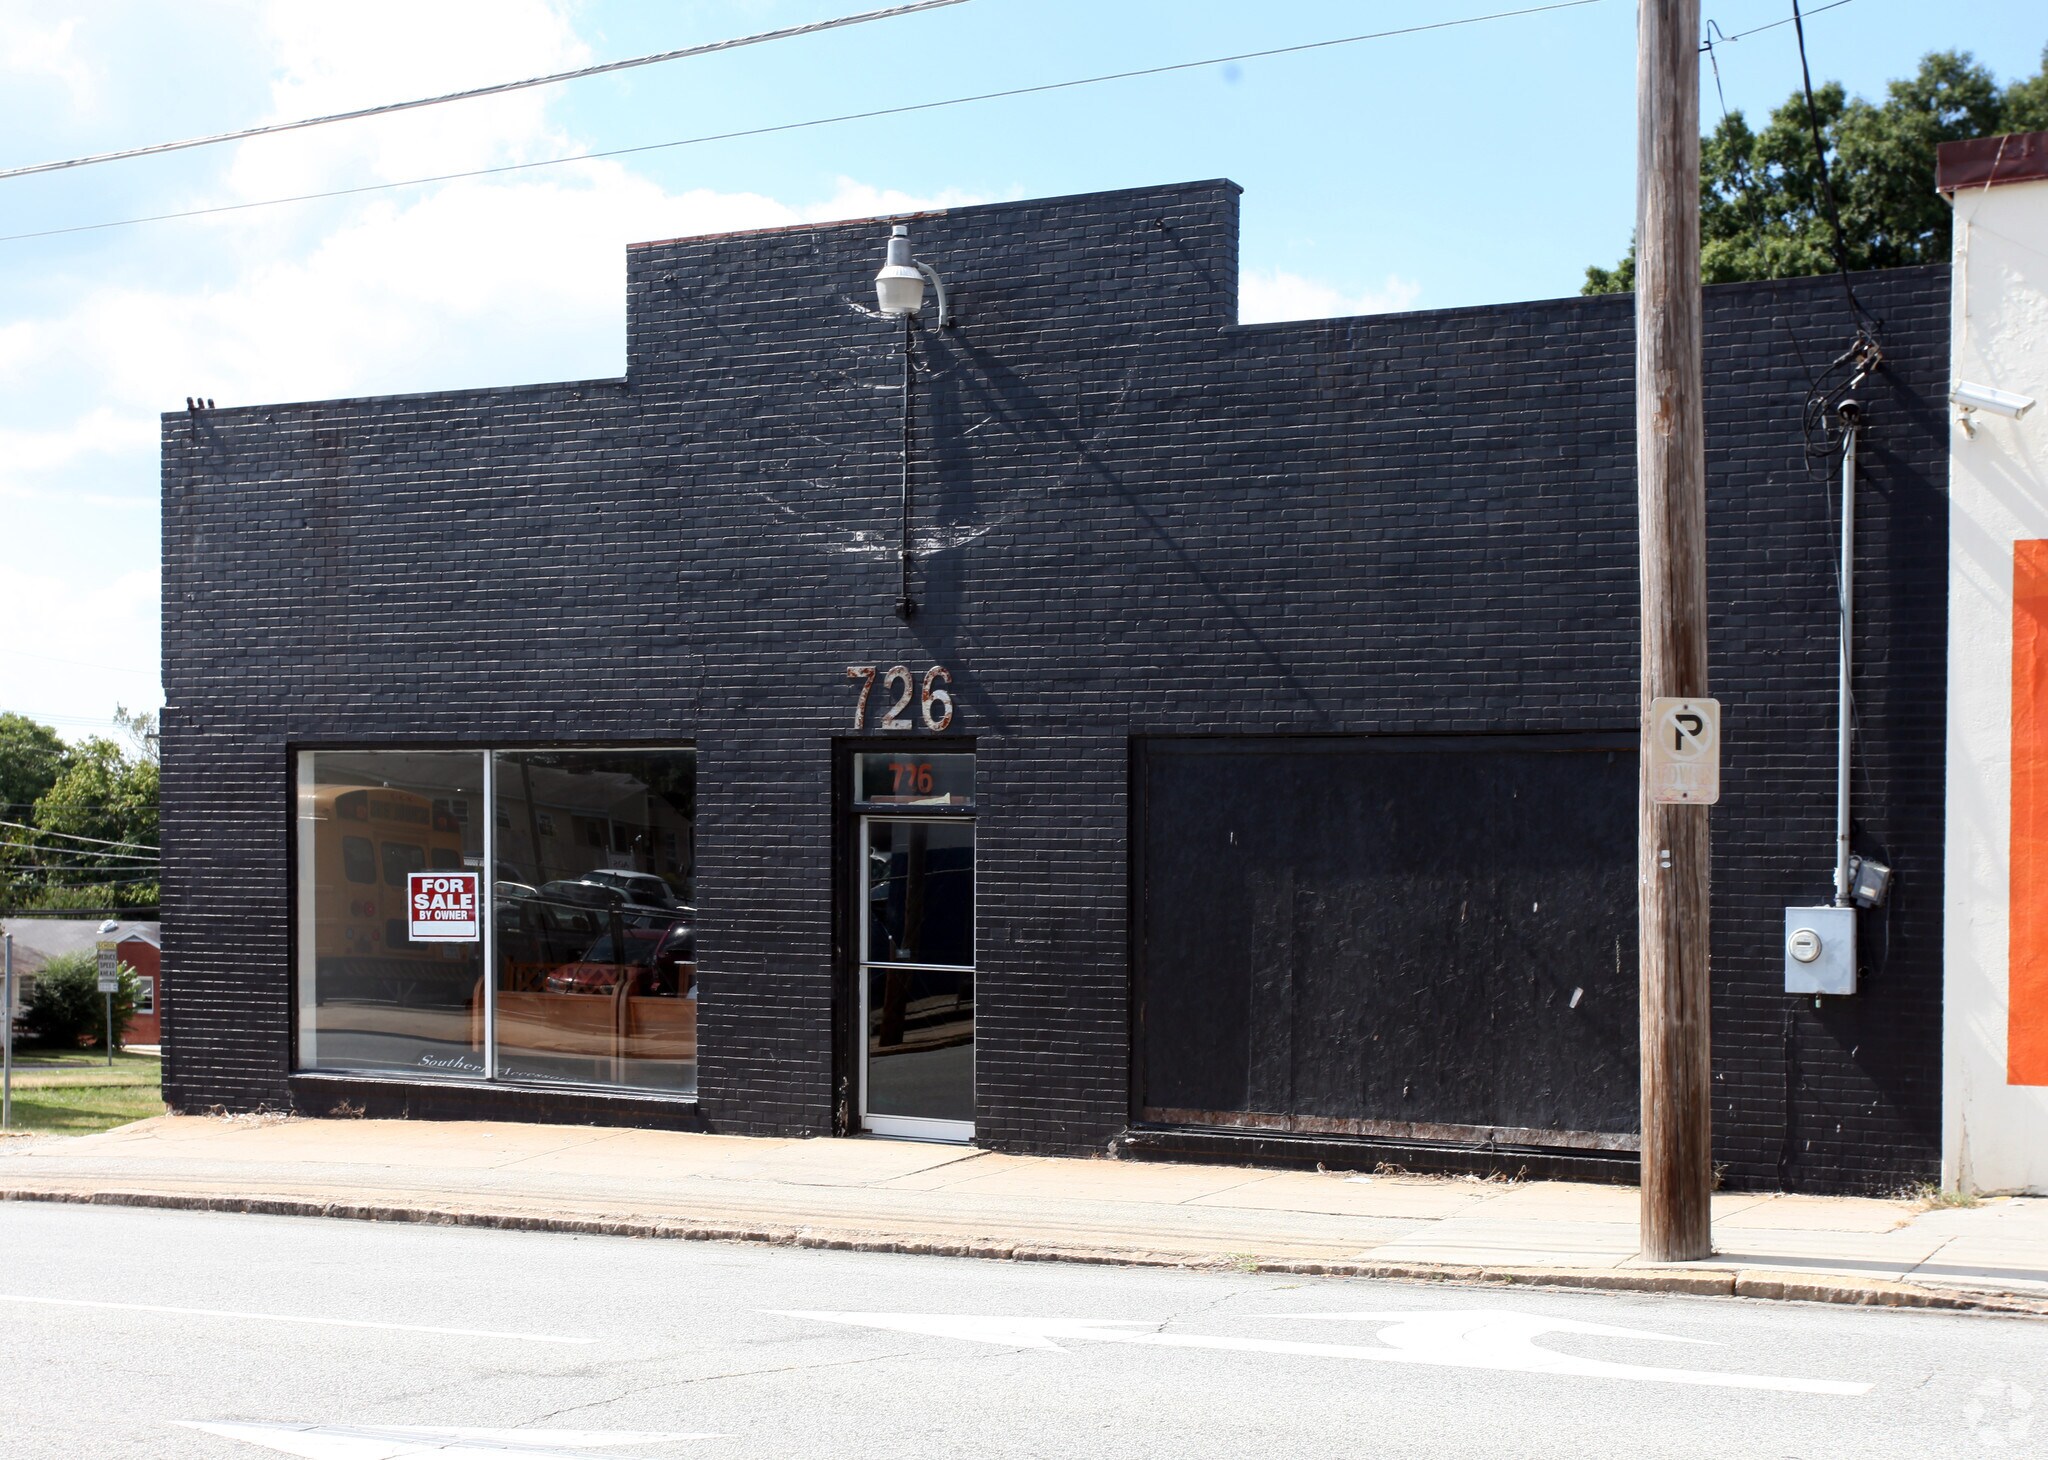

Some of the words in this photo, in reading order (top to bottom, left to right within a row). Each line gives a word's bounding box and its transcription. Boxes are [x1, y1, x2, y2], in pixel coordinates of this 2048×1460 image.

[847, 665, 953, 732] 726
[421, 878, 464, 893] FOR
[414, 893, 473, 910] SALE
[419, 910, 433, 920] BY
[434, 910, 468, 920] OWNER
